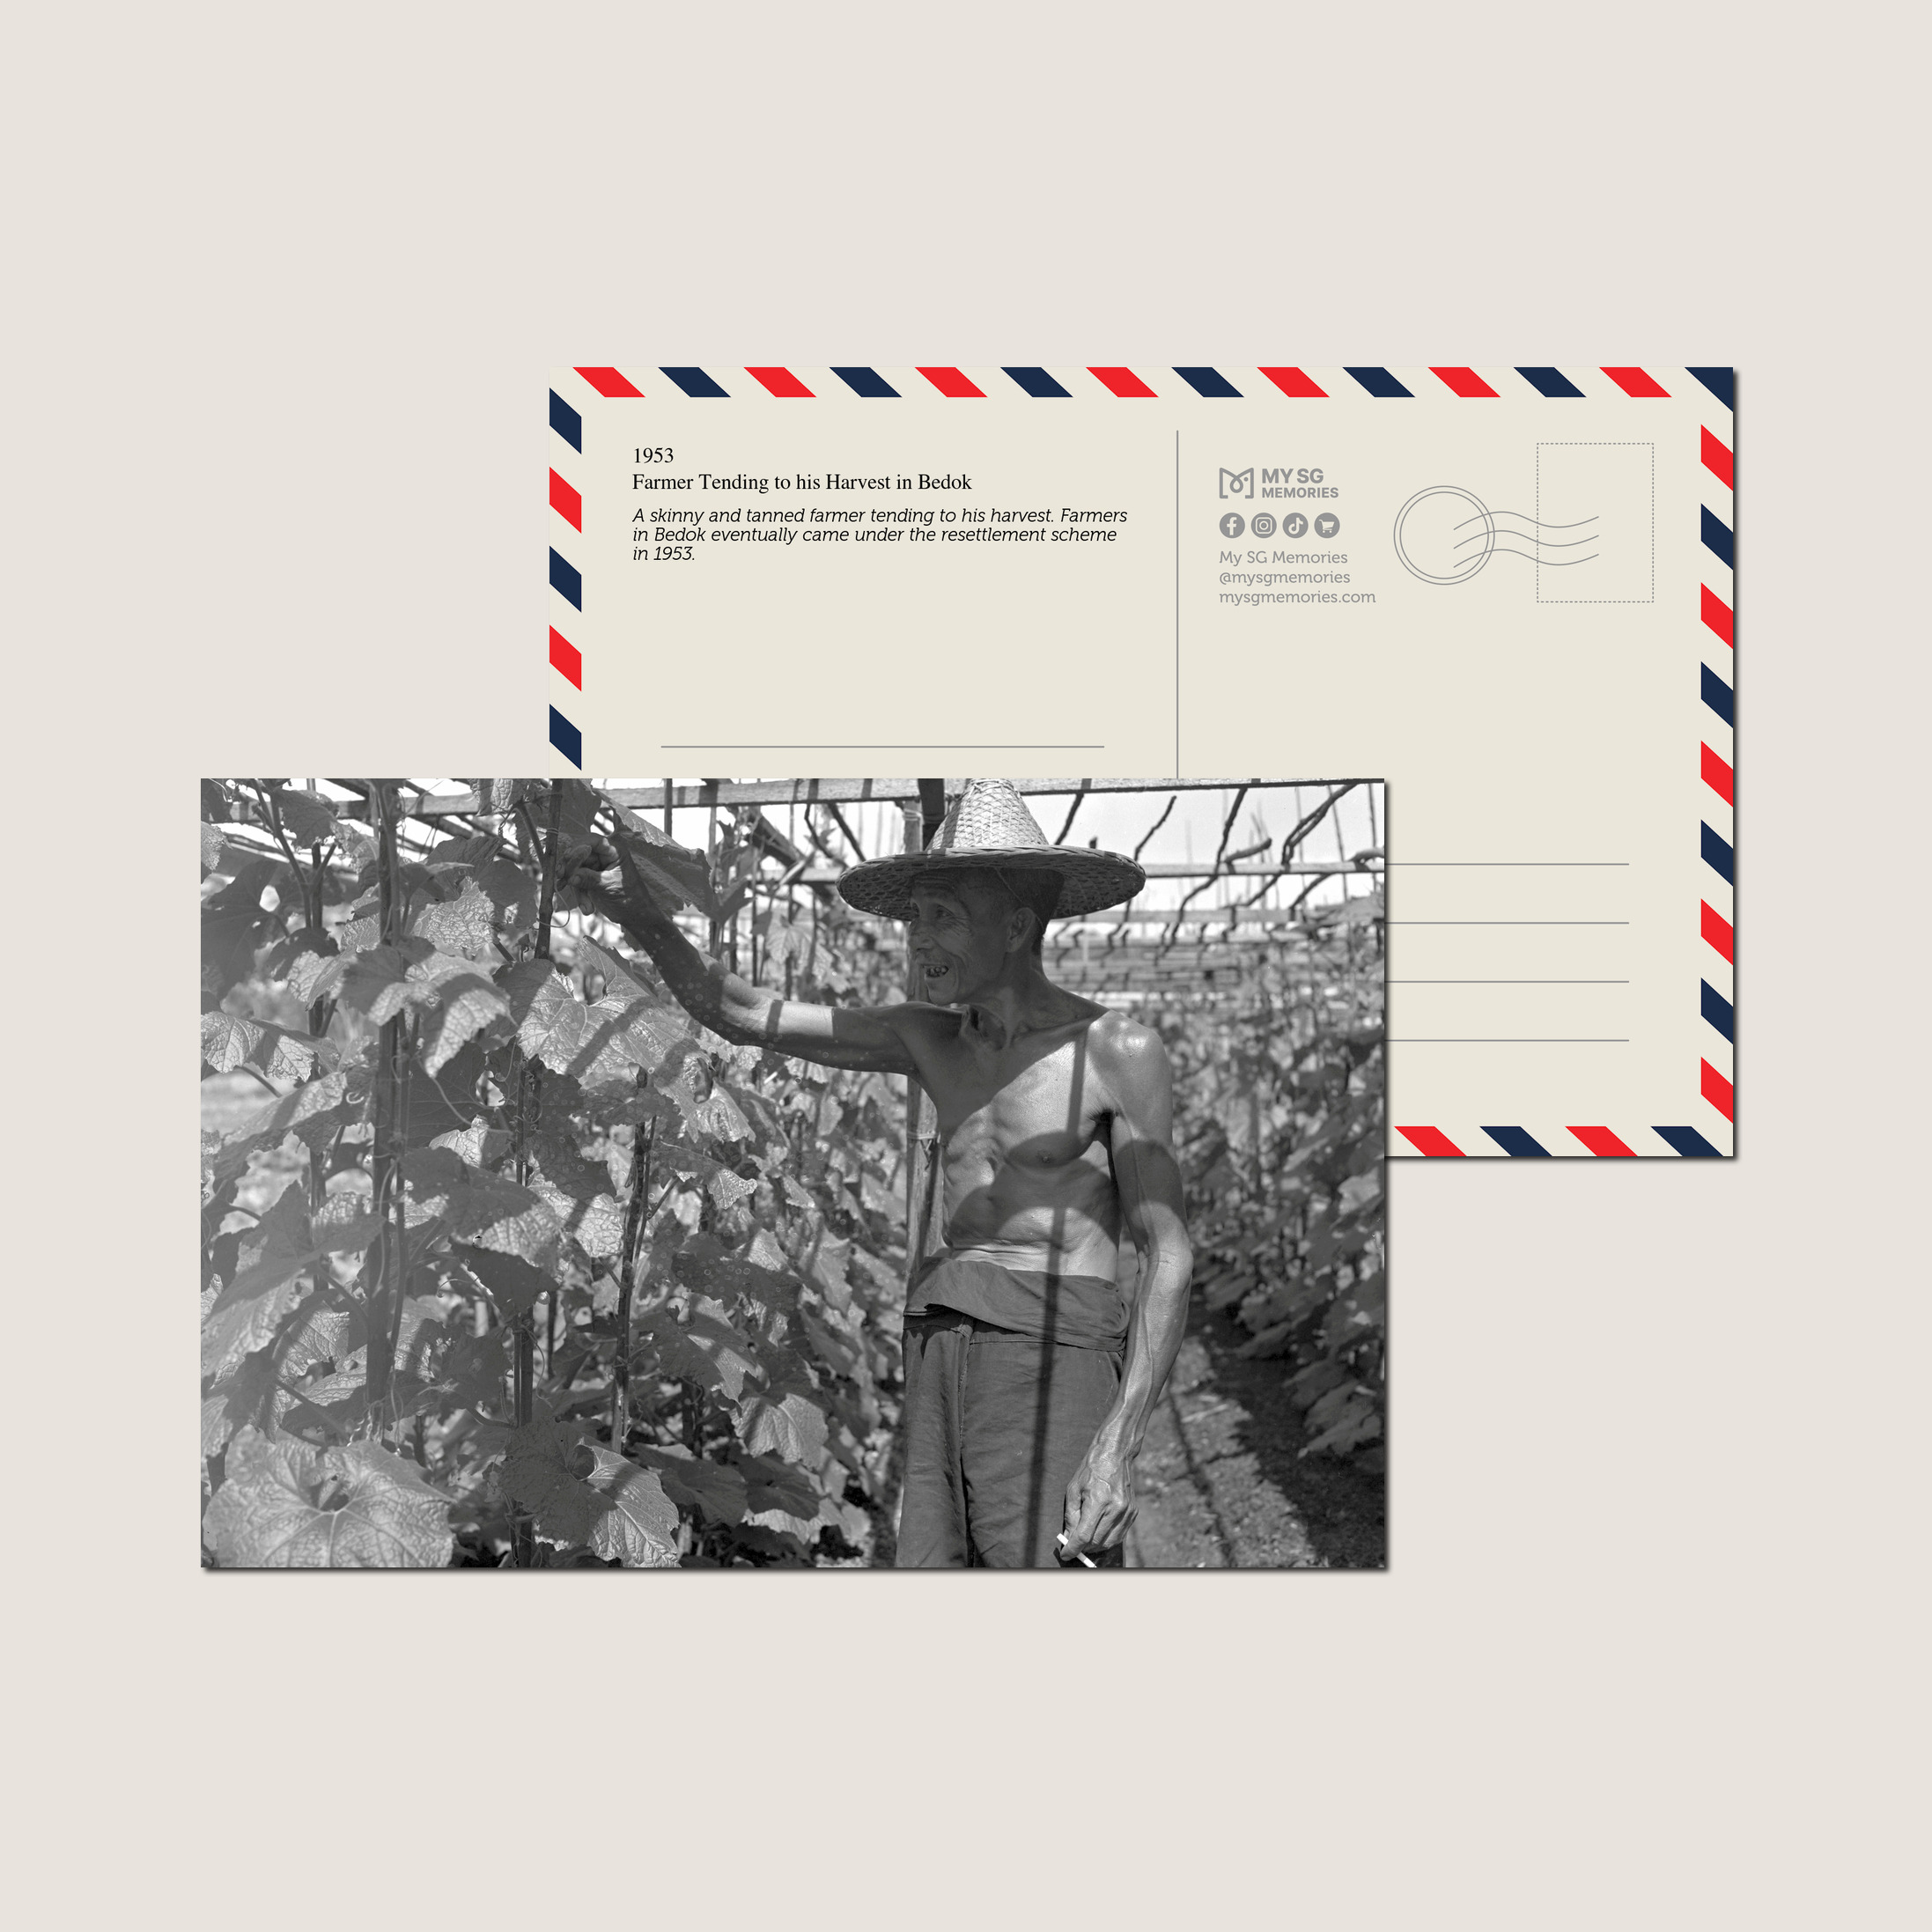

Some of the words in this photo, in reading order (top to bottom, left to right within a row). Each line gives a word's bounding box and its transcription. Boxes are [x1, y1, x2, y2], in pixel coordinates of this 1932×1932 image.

[633, 447, 674, 464] 1953
[1262, 468, 1294, 484] MY
[1296, 468, 1324, 484] SG
[632, 474, 695, 490] Farmer
[698, 474, 770, 495] Tending
[775, 476, 792, 490] to
[796, 474, 821, 490] his
[826, 474, 891, 490] Harvest
[896, 474, 912, 490] in
[918, 474, 973, 490] Bedok
[1262, 487, 1339, 498] MEMORIES
[632, 508, 645, 523] A
[650, 508, 704, 527] skinny
[709, 508, 742, 523] and
[747, 508, 806, 523] tanned
[810, 508, 866, 523] farmer
[870, 508, 935, 527] tending
[940, 509, 957, 523] to
[962, 508, 986, 523] his
[991, 508, 1054, 523] harvest.
[1060, 508, 1128, 523] Farmers
[632, 527, 648, 542] in
[654, 527, 707, 542] Bedok
[711, 527, 798, 546] eventually
[802, 531, 850, 542] came
[854, 527, 904, 542] under
[909, 527, 937, 542] the
[941, 527, 1046, 542] resettlement
[1051, 527, 1117, 542] scheme
[632, 547, 648, 561] in
[653, 547, 695, 561] 1953.
[1220, 551, 1243, 568] My
[1247, 551, 1268, 564] SG
[1272, 551, 1348, 564] Memories
[1220, 571, 1351, 587] @mysgmemories
[1220, 591, 1376, 607] mysgmemories.com
